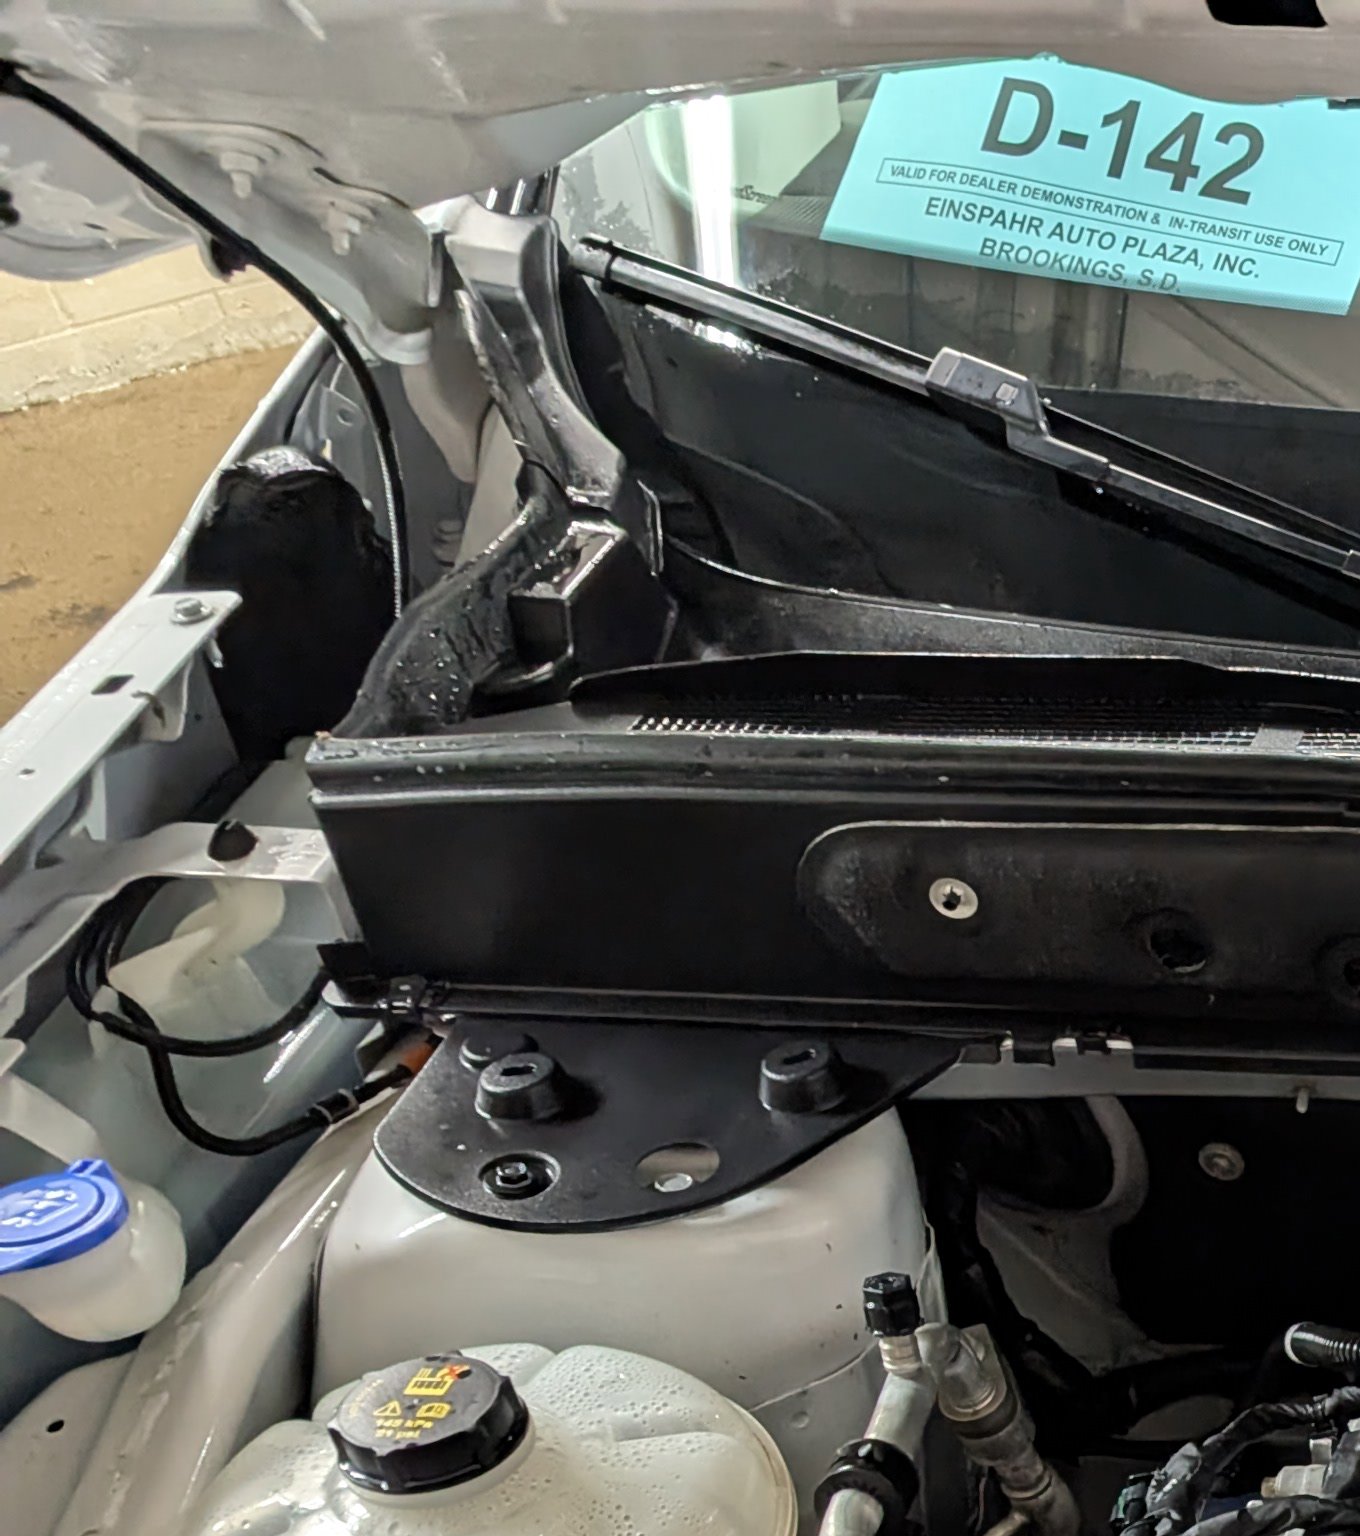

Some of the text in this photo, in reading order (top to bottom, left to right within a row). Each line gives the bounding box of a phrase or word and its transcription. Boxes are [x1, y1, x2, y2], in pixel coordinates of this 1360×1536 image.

[981, 78, 1265, 205] D-142
[890, 165, 1330, 257] VALID FOR DEALER DEMONSTRATION & IN-TRANSIT USE ONLY
[925, 197, 1260, 278] EINSPAHR AUTO PLAZA, INC.
